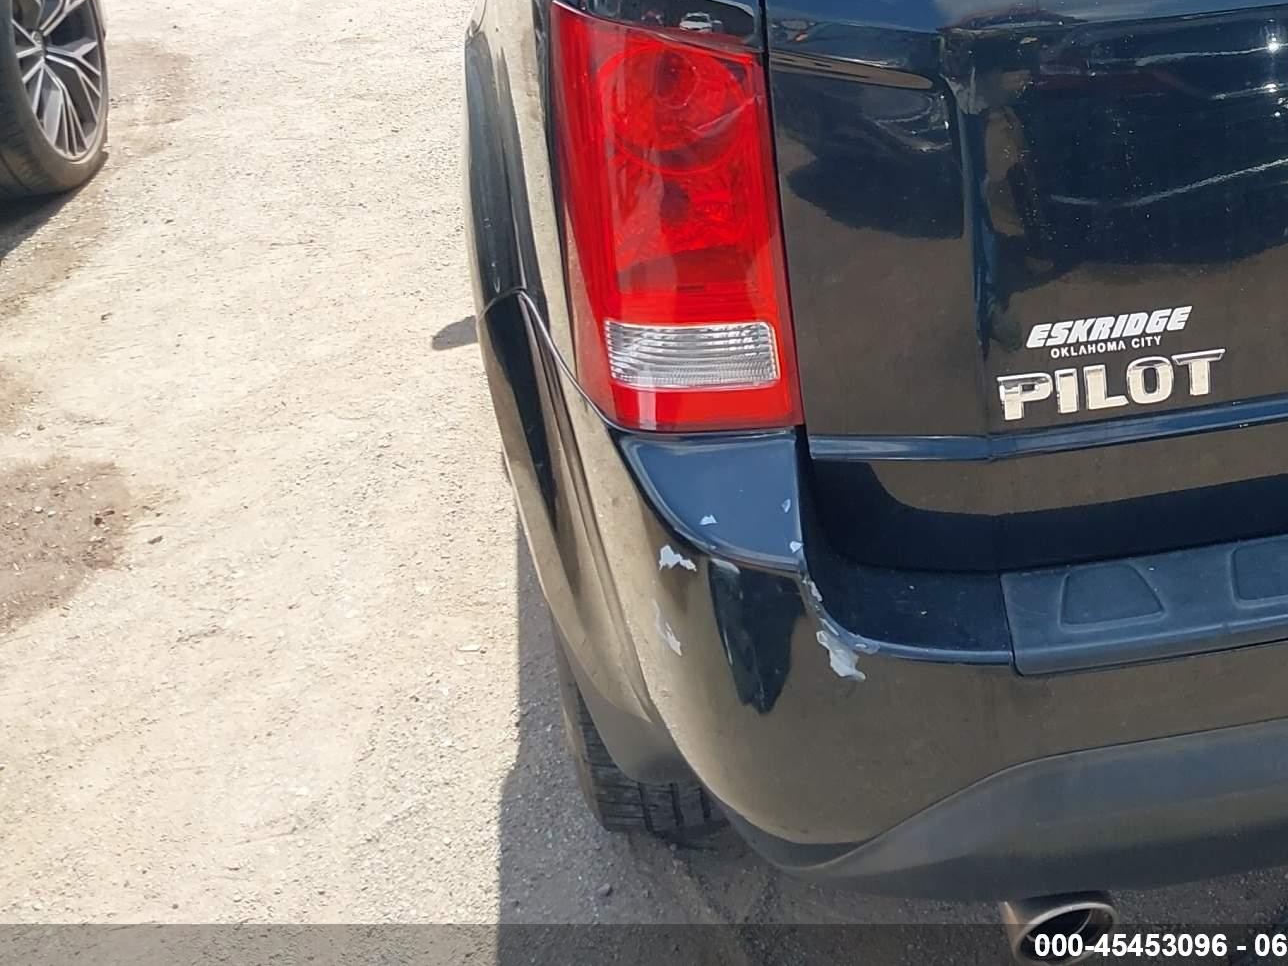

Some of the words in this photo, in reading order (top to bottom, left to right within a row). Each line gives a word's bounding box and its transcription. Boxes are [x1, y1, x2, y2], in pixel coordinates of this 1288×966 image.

[1025, 305, 1193, 349] ESKRIDGE
[1050, 340, 1127, 360] OKLAHOMA
[1131, 335, 1162, 350] CITY
[997, 348, 1226, 422] PILOT
